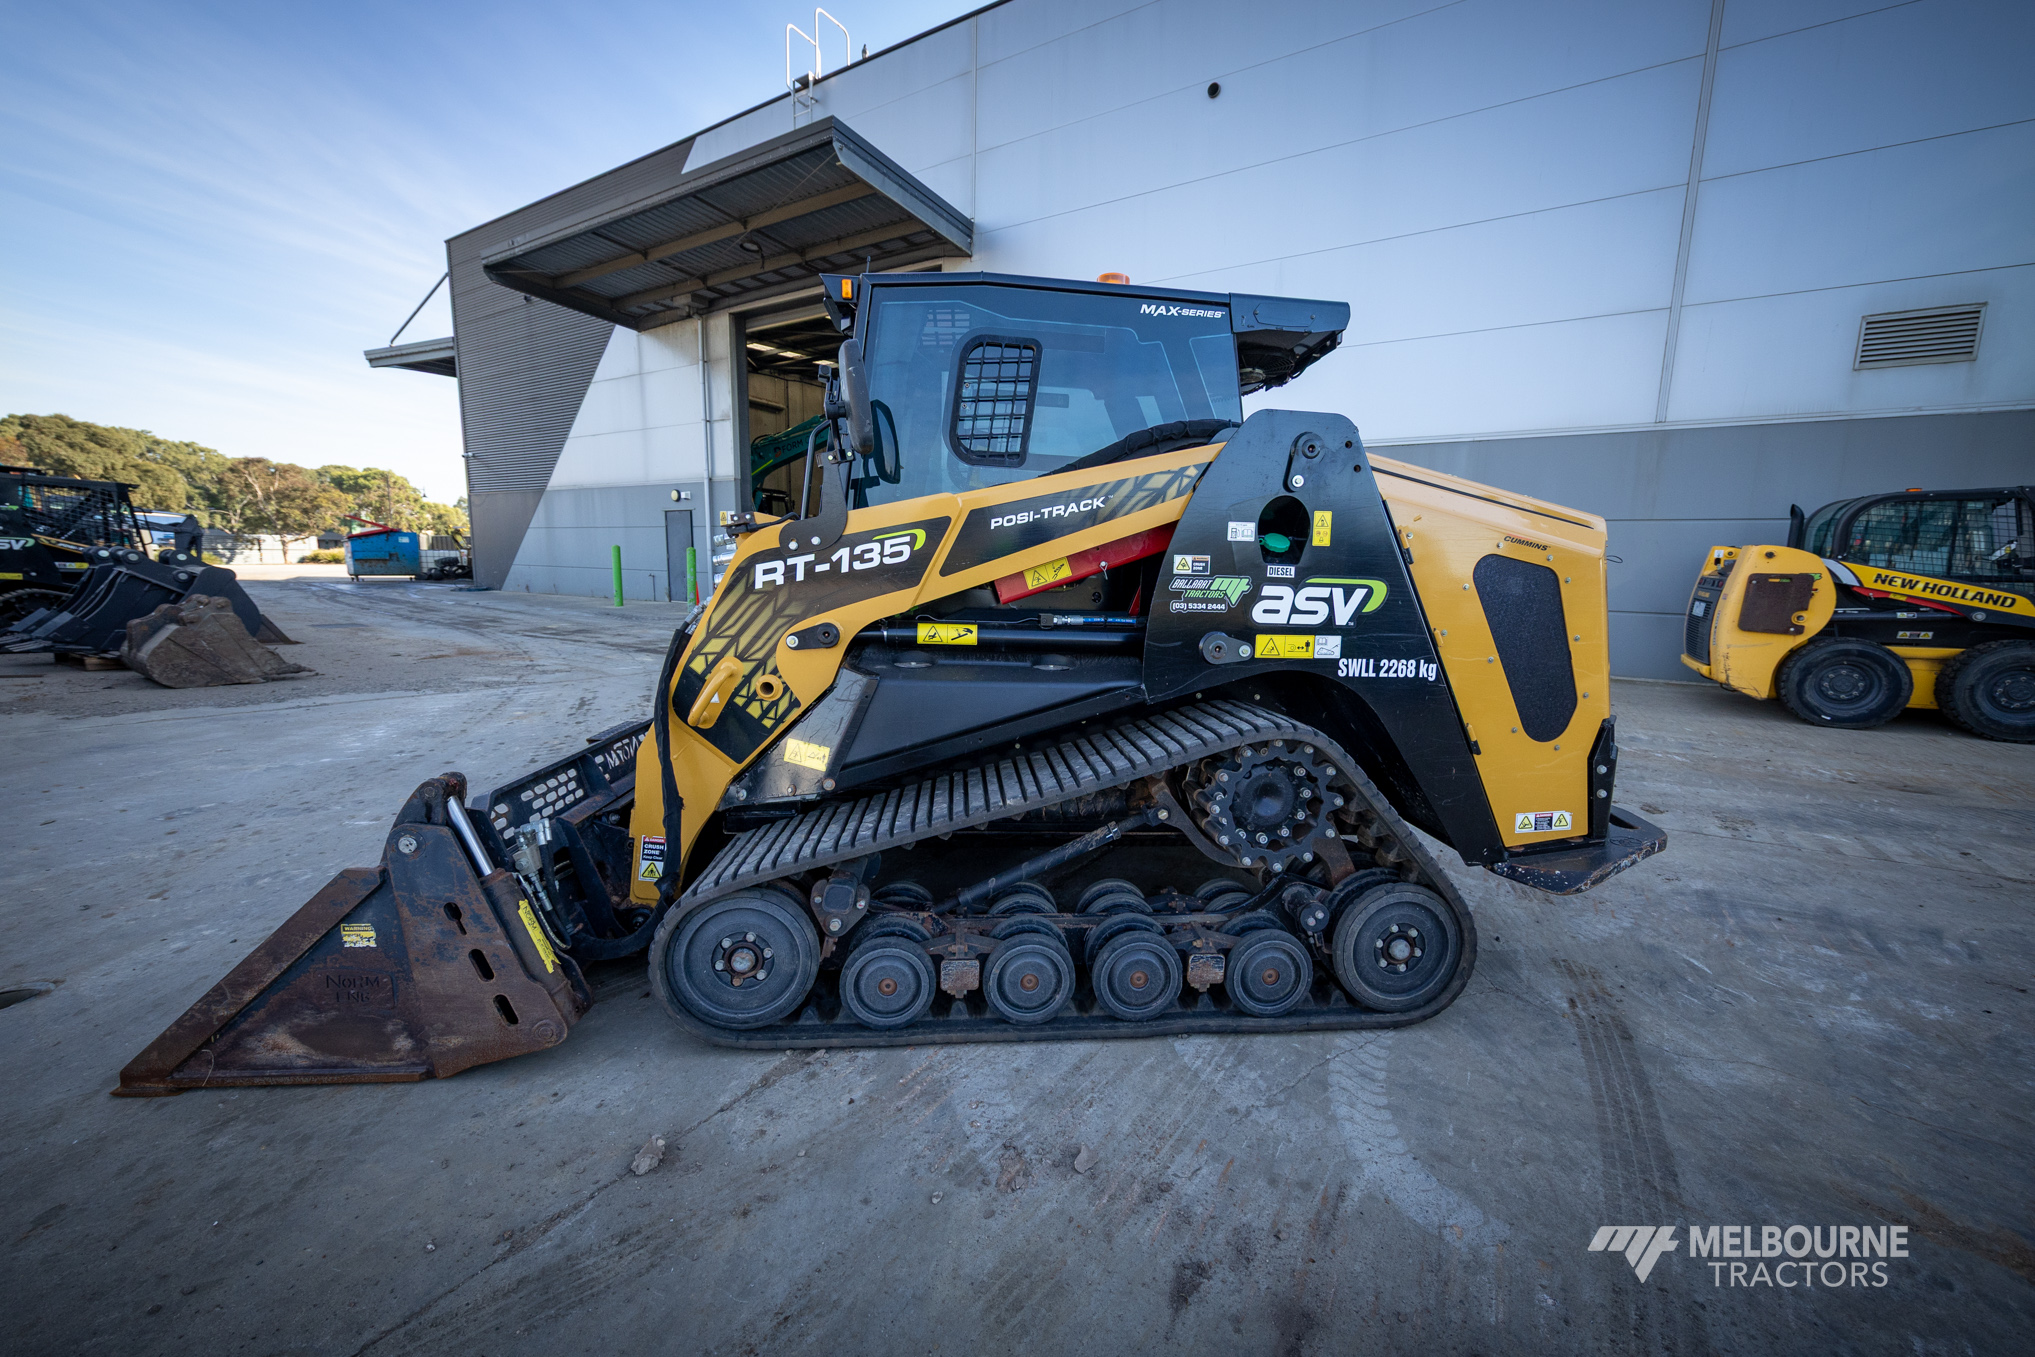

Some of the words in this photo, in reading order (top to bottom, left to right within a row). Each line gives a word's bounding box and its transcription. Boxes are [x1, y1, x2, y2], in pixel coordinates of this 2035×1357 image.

[990, 496, 1106, 529] POSI-TRACK
[1503, 536, 1548, 551] CUMMINS
[754, 536, 911, 589] RT-135
[1268, 567, 1293, 576] DIESEL
[1171, 579, 1213, 589] BALLARAT
[1873, 573, 1921, 590] NEW
[1921, 582, 2017, 608] HOLLAND
[1184, 589, 1226, 598] TRACTORS
[1172, 602, 1187, 610] (03)
[1338, 658, 1376, 677] SWLL
[1379, 659, 1416, 678] 2268
[1418, 659, 1437, 682] kg
